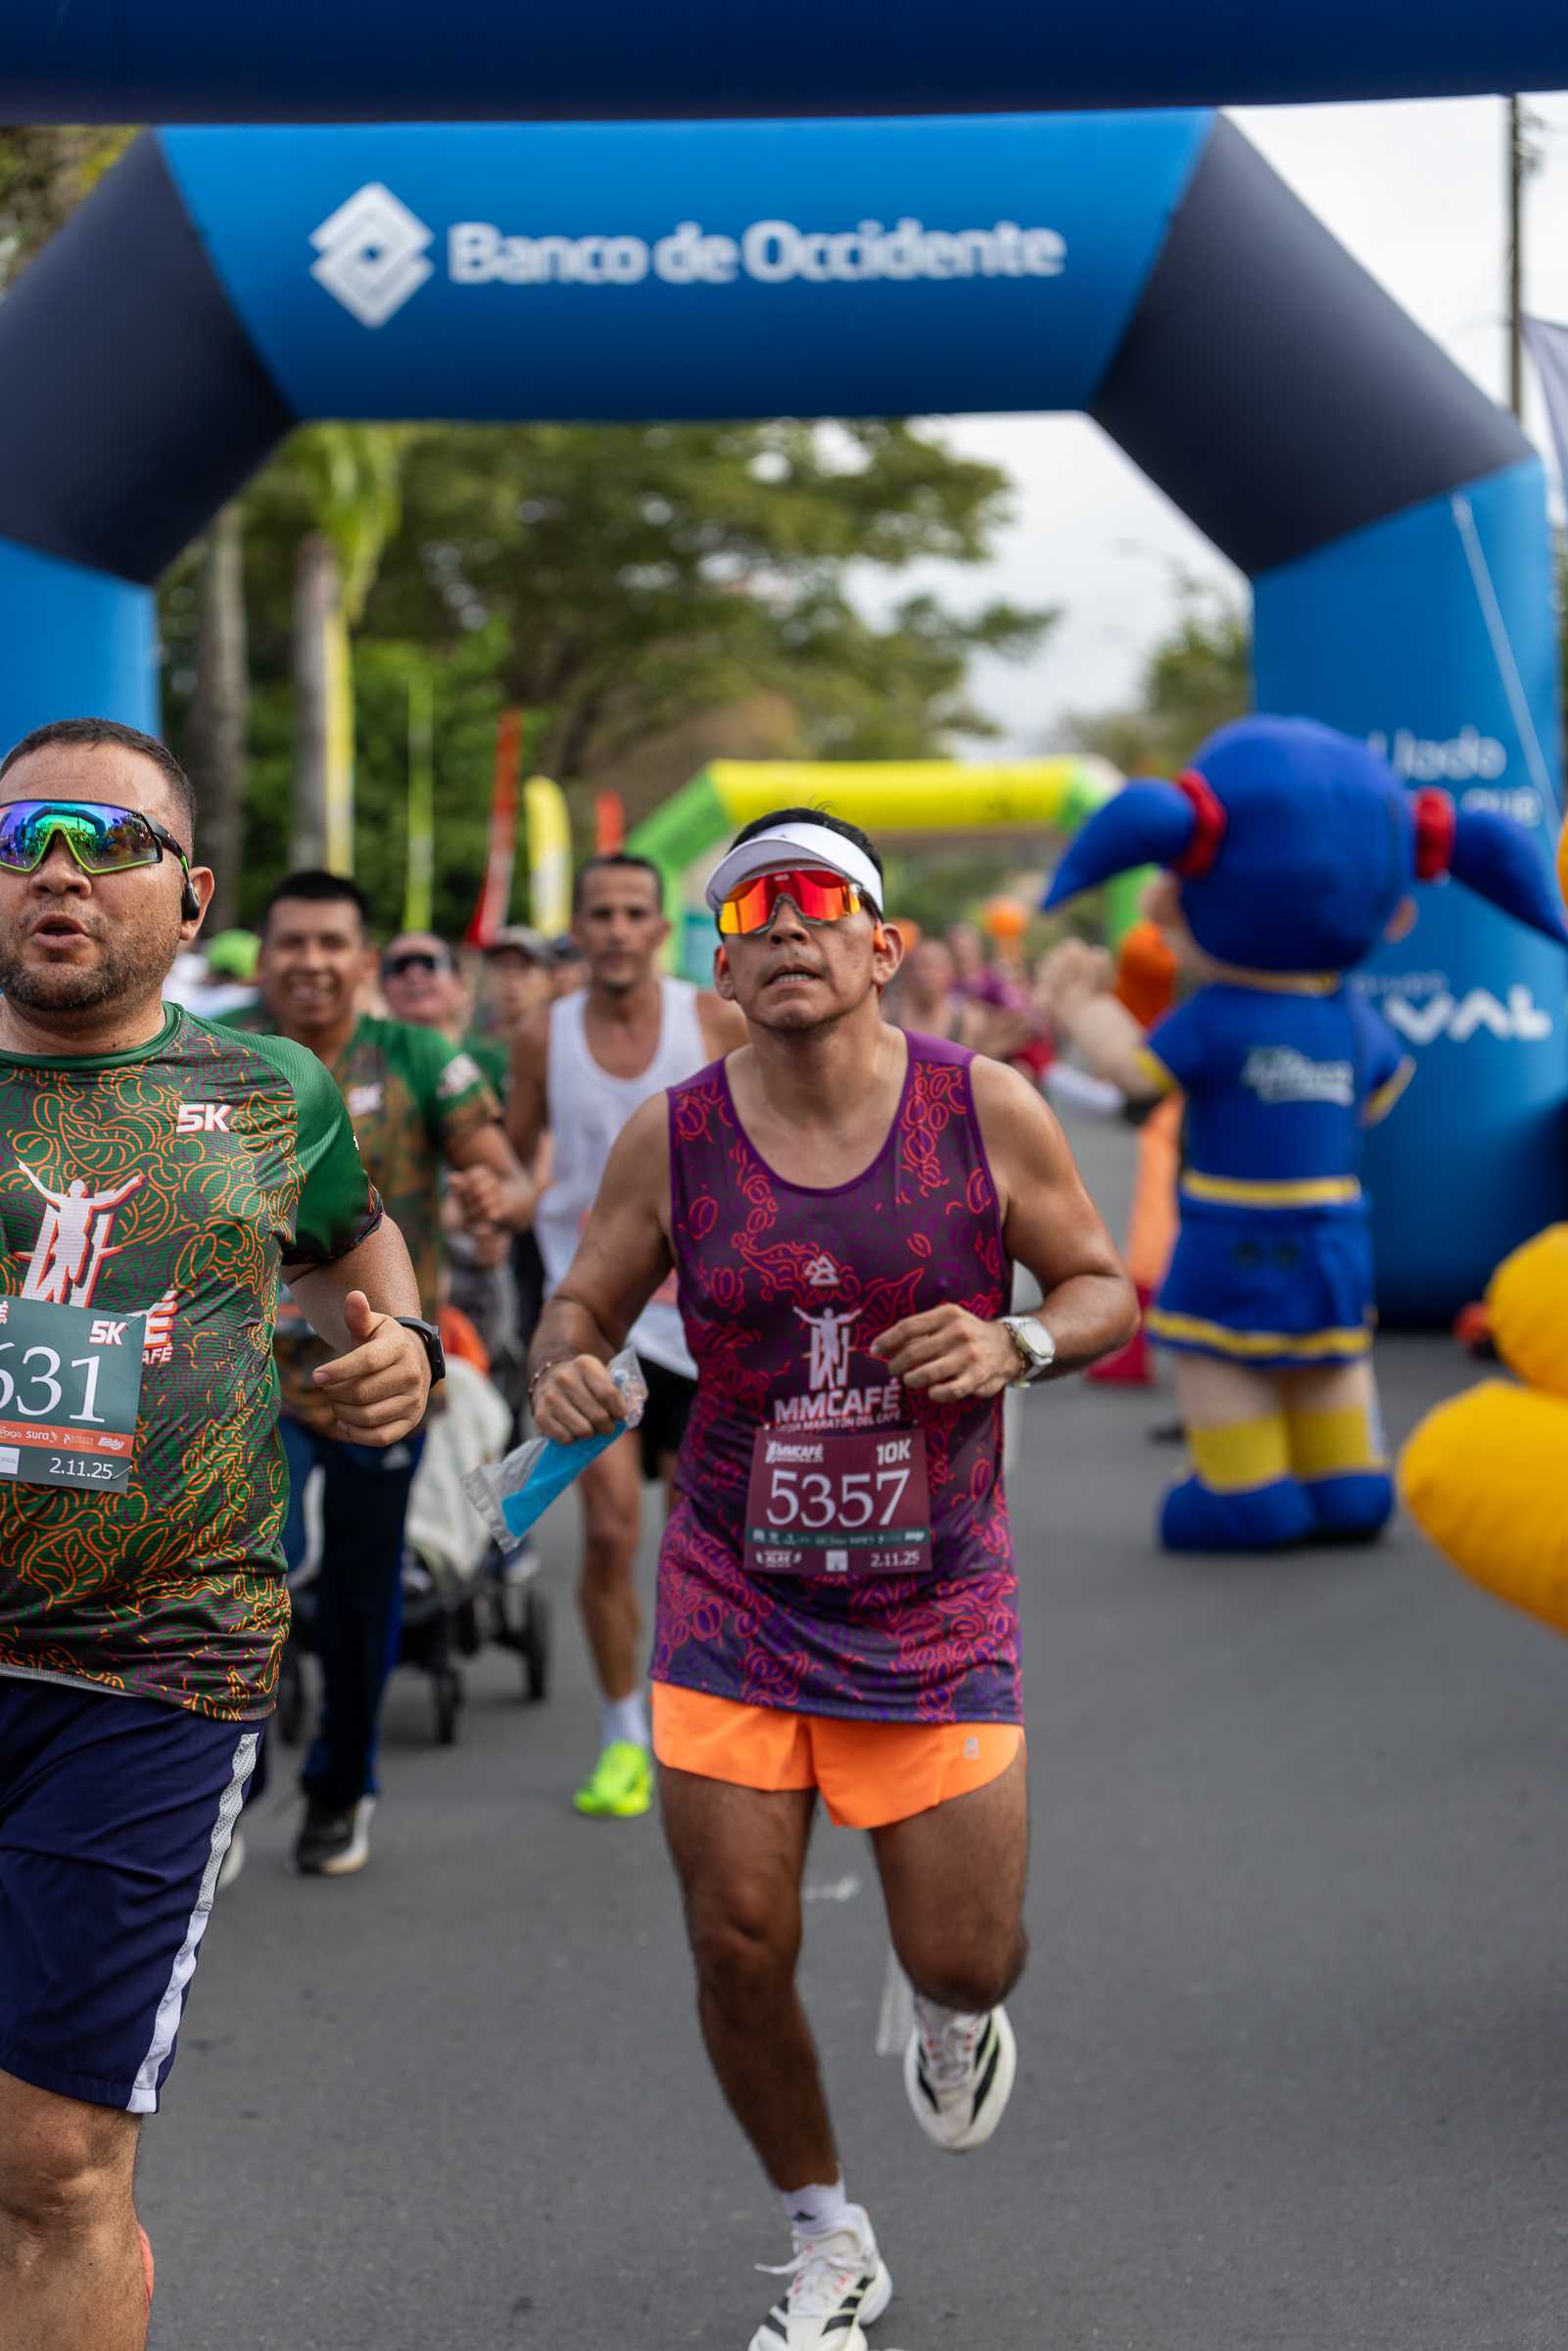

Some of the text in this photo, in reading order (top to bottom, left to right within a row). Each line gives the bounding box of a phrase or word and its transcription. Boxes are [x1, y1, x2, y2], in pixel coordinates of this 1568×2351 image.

[448, 216, 1067, 285] Banco de Occidente
[1384, 984, 1553, 1045] VAL
[176, 1103, 233, 1133] 5K
[89, 1319, 127, 1346] 5K
[141, 1344, 173, 1365] AFÉ
[774, 1377, 901, 1423] MMCAFÉ
[25, 1430, 50, 1442] sura
[877, 1438, 912, 1465] 10K
[49, 1457, 114, 1480] 2.11.25
[767, 1469, 911, 1528] 5357
[871, 1551, 921, 1568] 2.11.25
